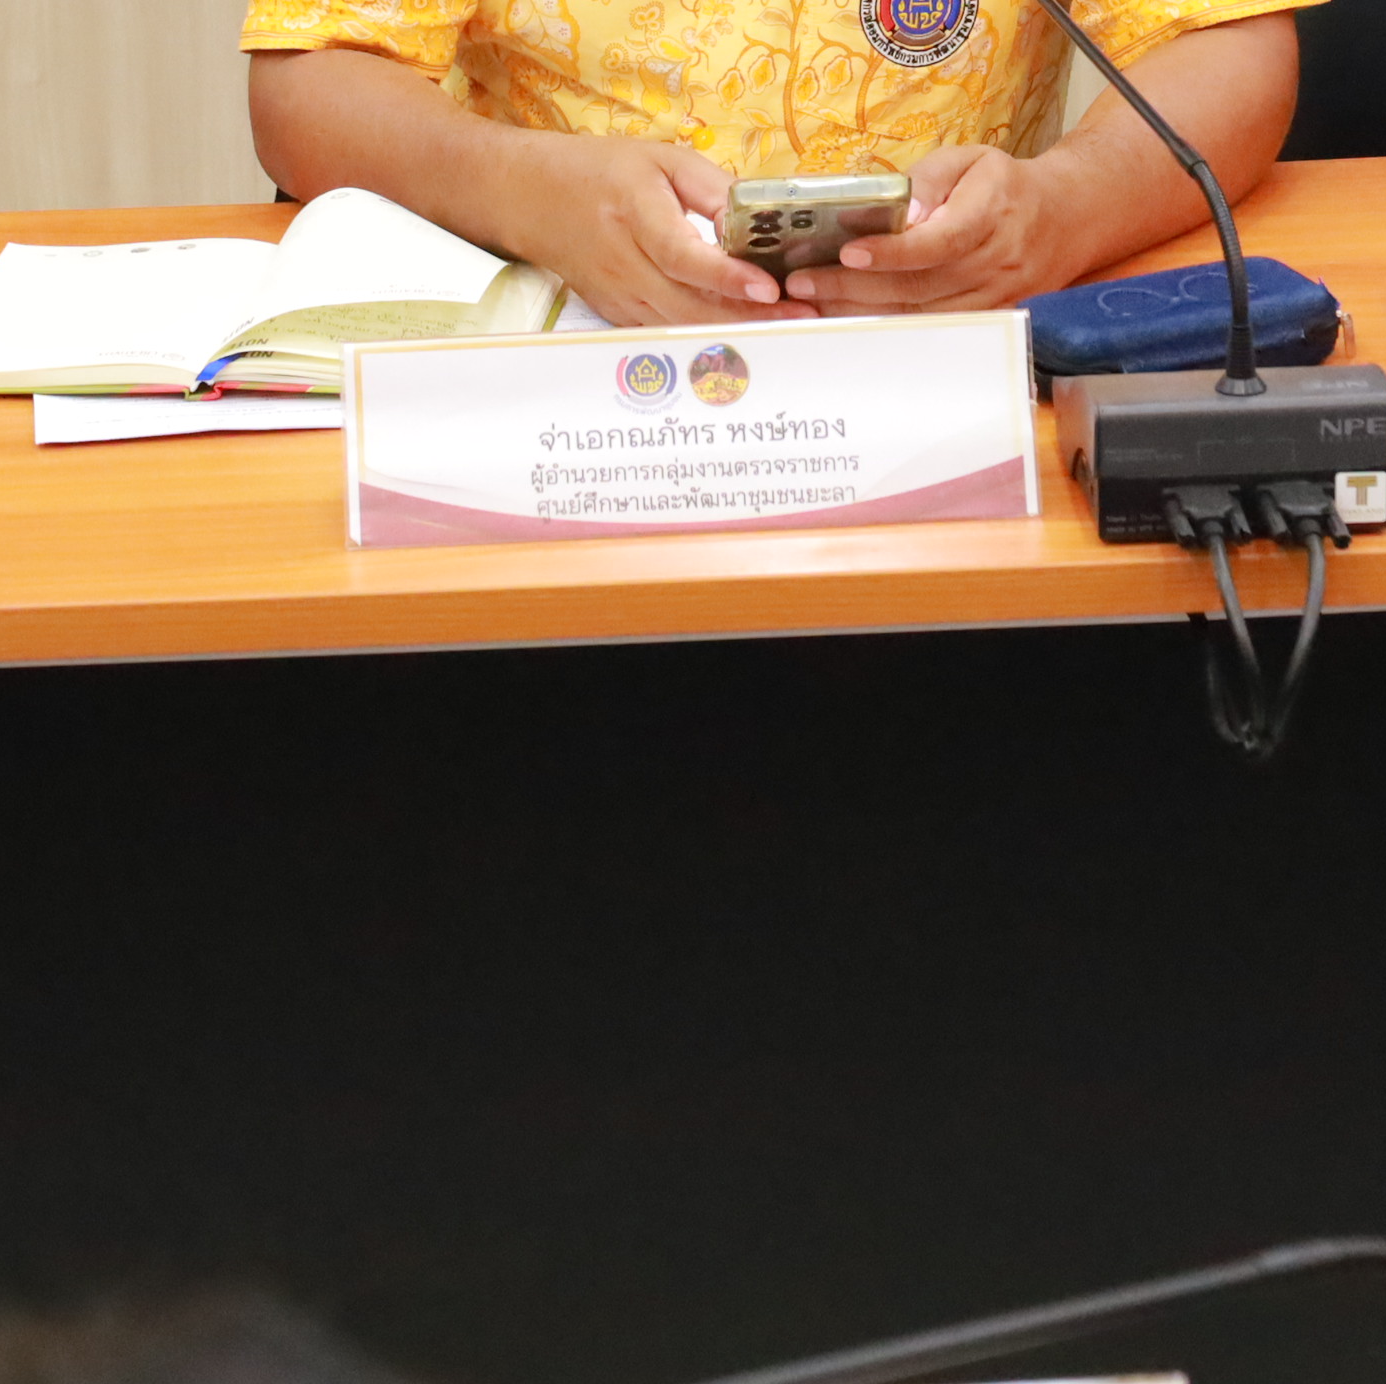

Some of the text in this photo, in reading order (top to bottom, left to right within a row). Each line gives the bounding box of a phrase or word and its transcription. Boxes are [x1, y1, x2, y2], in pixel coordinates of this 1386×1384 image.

[539, 411, 847, 452] จ่าเอกณภัทร หงษ์ทอง
[530, 454, 859, 493] ผู้อำนวยการกลุ่มงานตรวจราชการ
[537, 485, 856, 523] ศูนย์ศึกษาและพัฒนาชุมชนยะลา
